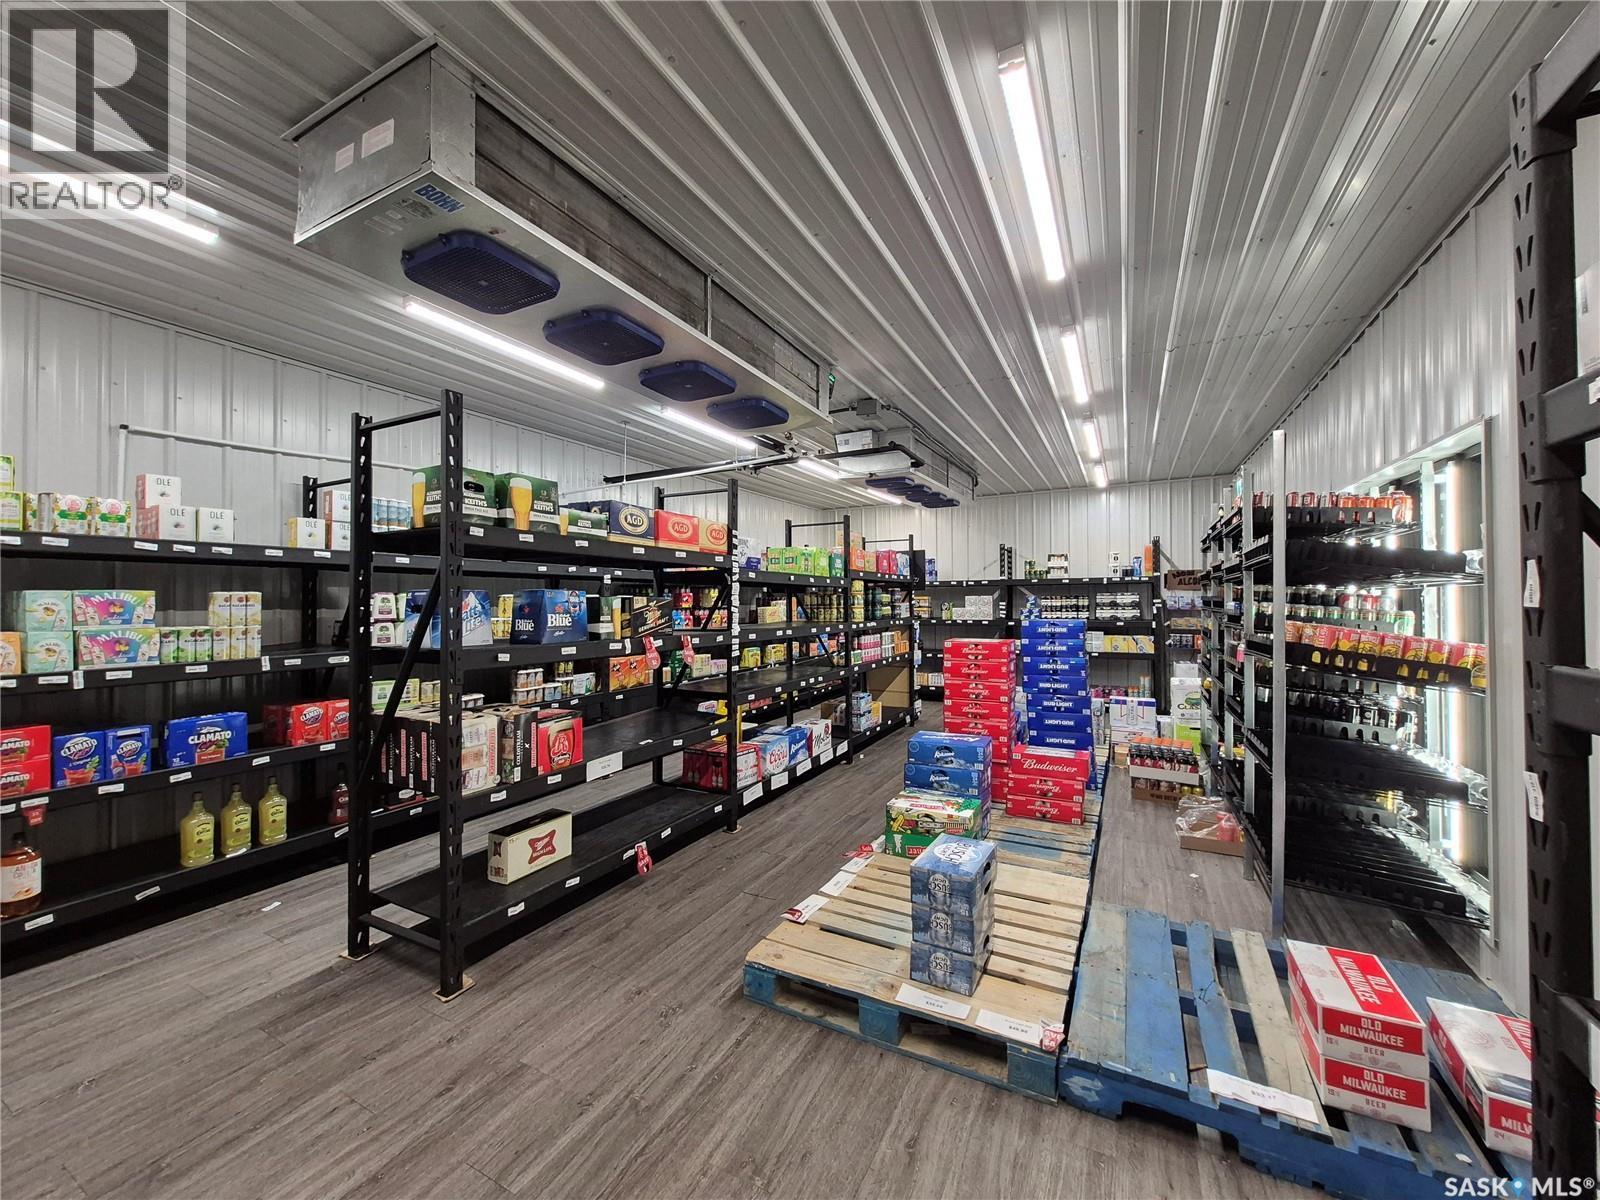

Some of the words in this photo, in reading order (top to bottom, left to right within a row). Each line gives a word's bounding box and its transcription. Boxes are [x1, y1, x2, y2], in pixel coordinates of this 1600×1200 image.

[170, 508, 185, 517] OLE
[210, 511, 225, 520] OLE
[626, 514, 643, 526] AGD
[673, 523, 689, 533] AGD
[711, 531, 724, 539] AGD
[90, 591, 142, 605] MALIBU
[515, 619, 535, 631] Blue
[547, 613, 572, 627] Blue
[96, 630, 145, 644] MALIBU
[188, 730, 232, 745] CLAMATO
[61, 738, 98, 756] CLAMATO
[769, 745, 788, 765] Coors
[1021, 758, 1078, 773] Budweiser
[1335, 955, 1381, 1006] MILWAUKEE
[1366, 974, 1394, 993] OLD
[1361, 1017, 1382, 1031] OLD
[1340, 1023, 1404, 1048] MILWAUKEE
[1363, 1046, 1385, 1057] BEER
[1363, 1069, 1385, 1083] OLD
[1342, 1075, 1407, 1101] MILWAUKEE
[1365, 1098, 1387, 1110] BEER
